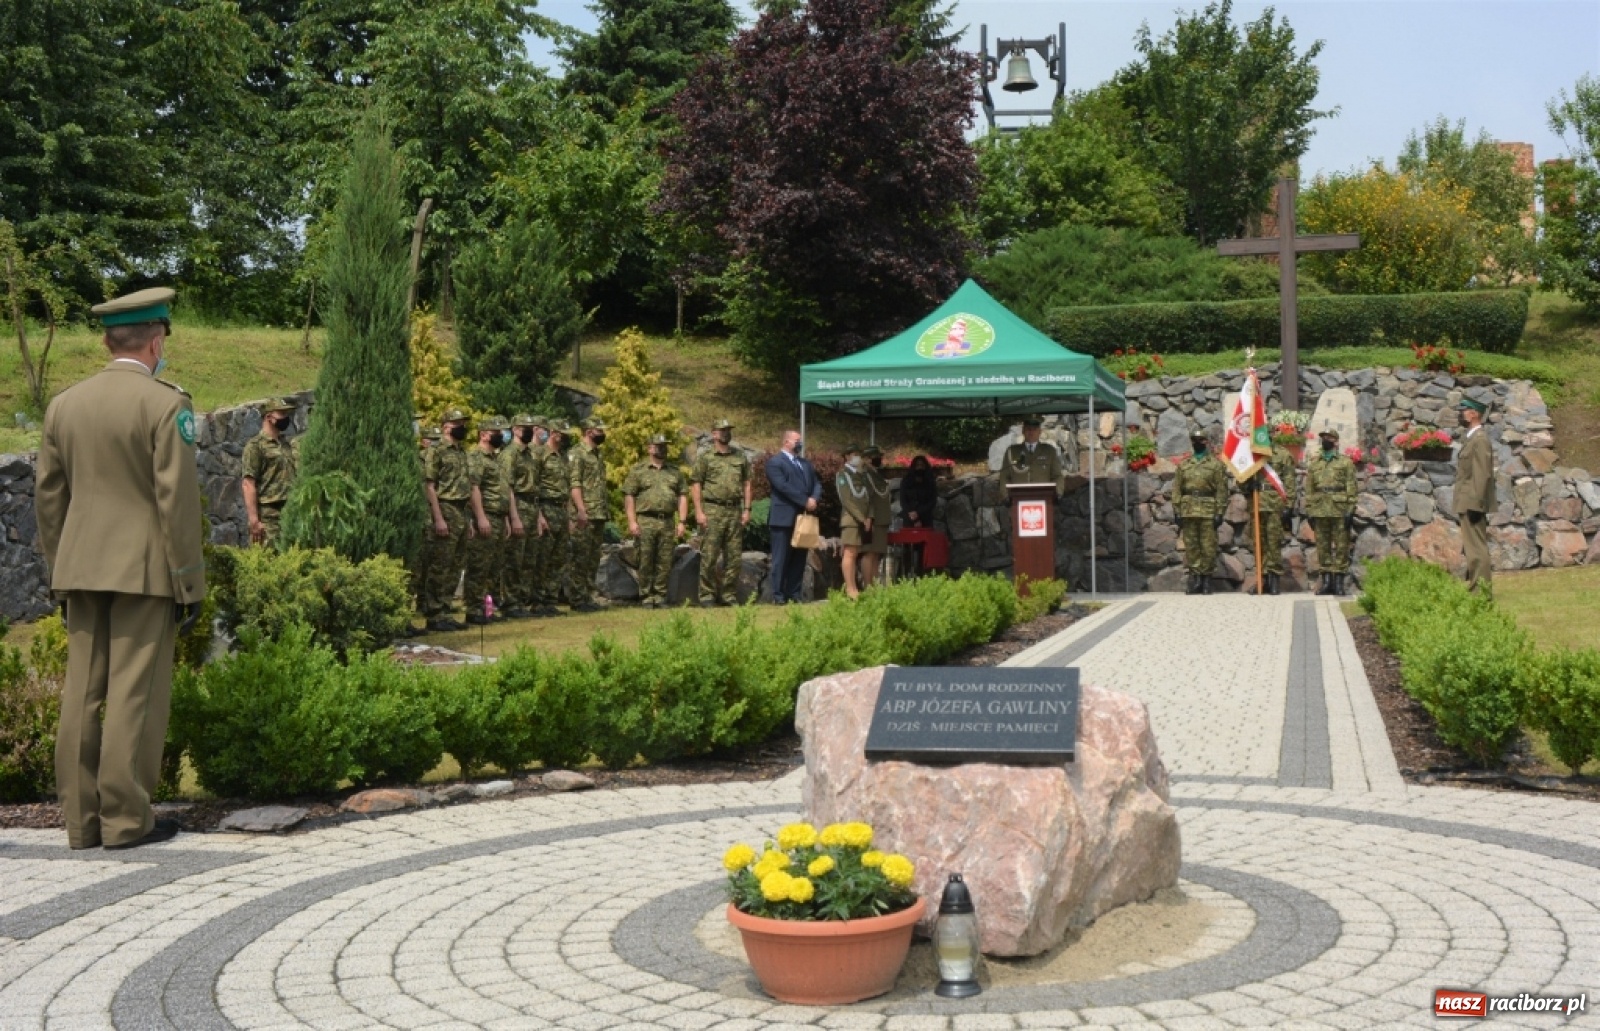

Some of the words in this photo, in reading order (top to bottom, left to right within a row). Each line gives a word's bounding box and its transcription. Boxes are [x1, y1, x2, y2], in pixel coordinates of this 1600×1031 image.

[884, 377, 914, 388] Straży
[916, 377, 966, 386] Granicznej
[1027, 374, 1076, 382] Raciborzu
[894, 682, 912, 693] TU
[949, 682, 984, 693] DOM
[987, 682, 1067, 693] RODZINNY
[880, 700, 916, 714] ABP
[918, 697, 982, 715] JÓZEFA
[987, 700, 1072, 715] GAWLINY
[930, 722, 992, 733] MIEJSCE
